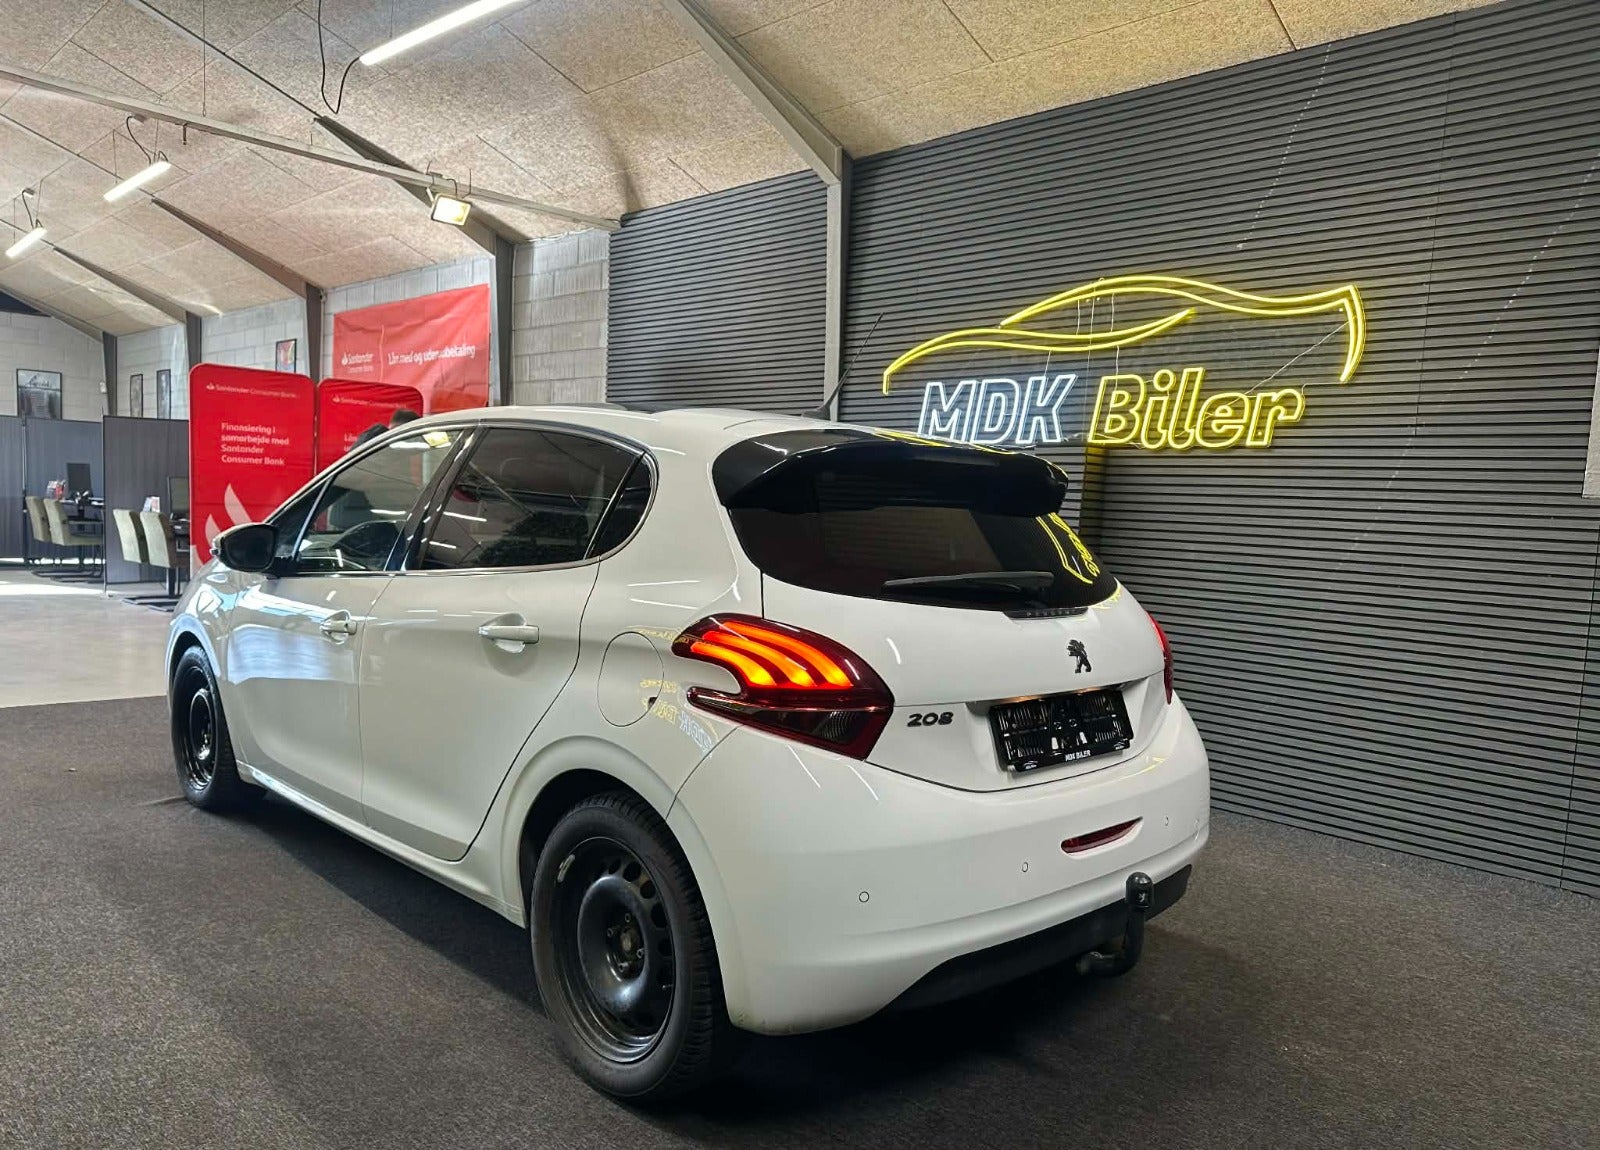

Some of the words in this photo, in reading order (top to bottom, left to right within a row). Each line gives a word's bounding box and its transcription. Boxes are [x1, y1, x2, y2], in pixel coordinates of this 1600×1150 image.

[414, 351, 423, 365] og
[216, 384, 249, 393] Santander
[917, 374, 1078, 445] MDK
[1087, 366, 1306, 450] Biler
[221, 422, 272, 435] Finansiering
[221, 434, 270, 445] samarbejde
[271, 436, 290, 446] med
[221, 443, 264, 454] Santander
[221, 454, 263, 465] Consumer
[264, 456, 285, 466] Bank
[906, 711, 954, 728] 208
